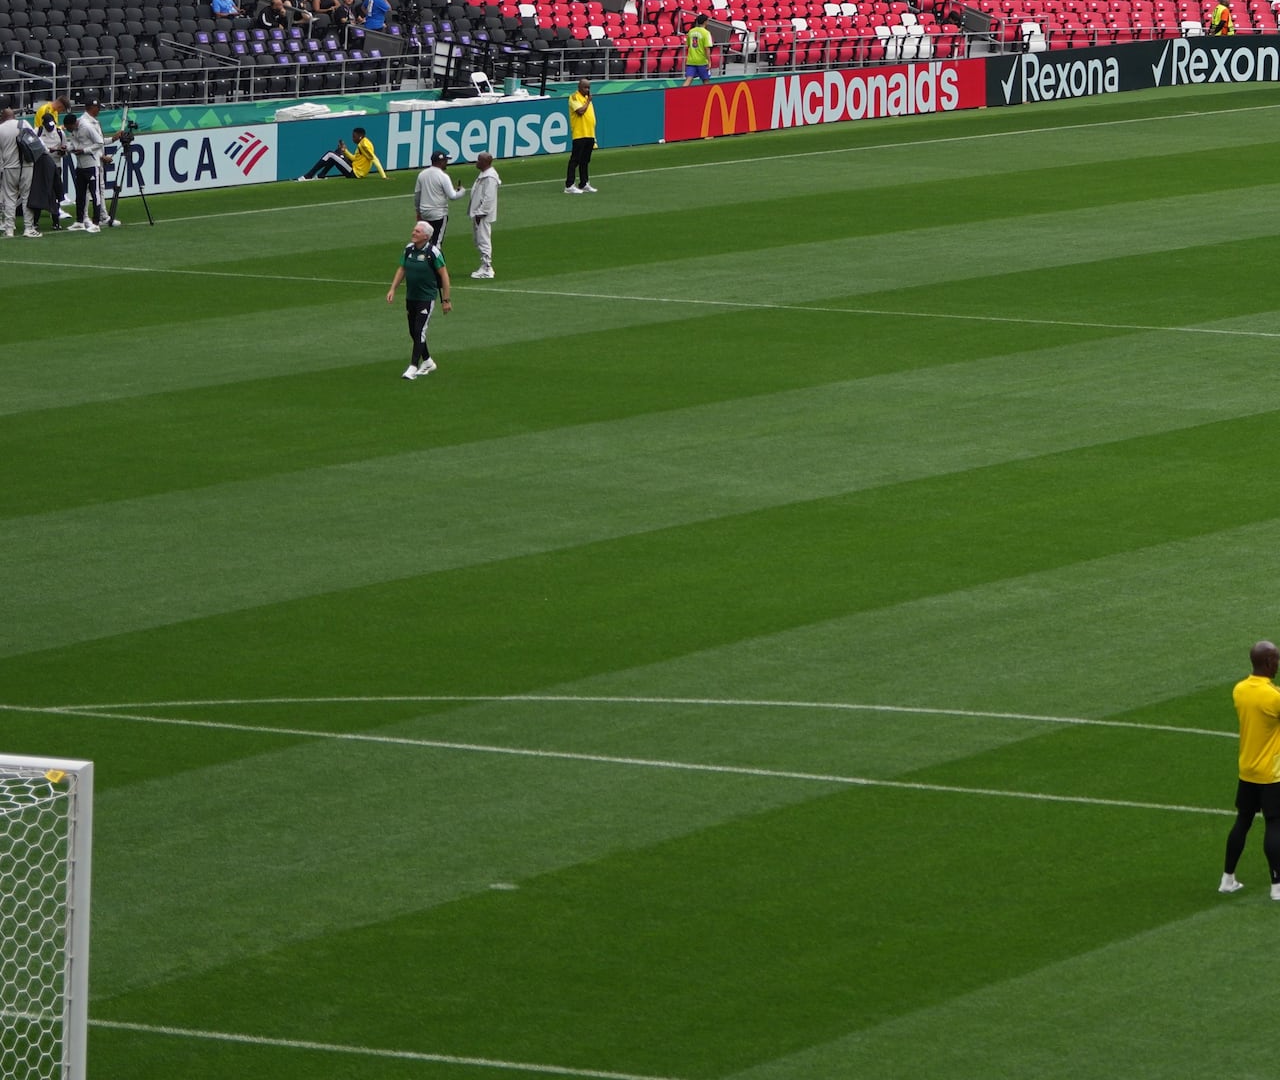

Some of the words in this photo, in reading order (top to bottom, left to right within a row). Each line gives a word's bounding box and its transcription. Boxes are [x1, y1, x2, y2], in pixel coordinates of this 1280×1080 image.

[770, 61, 959, 130] McDonald's
[1021, 53, 1119, 103] Rexona
[386, 110, 569, 171] Hisense
